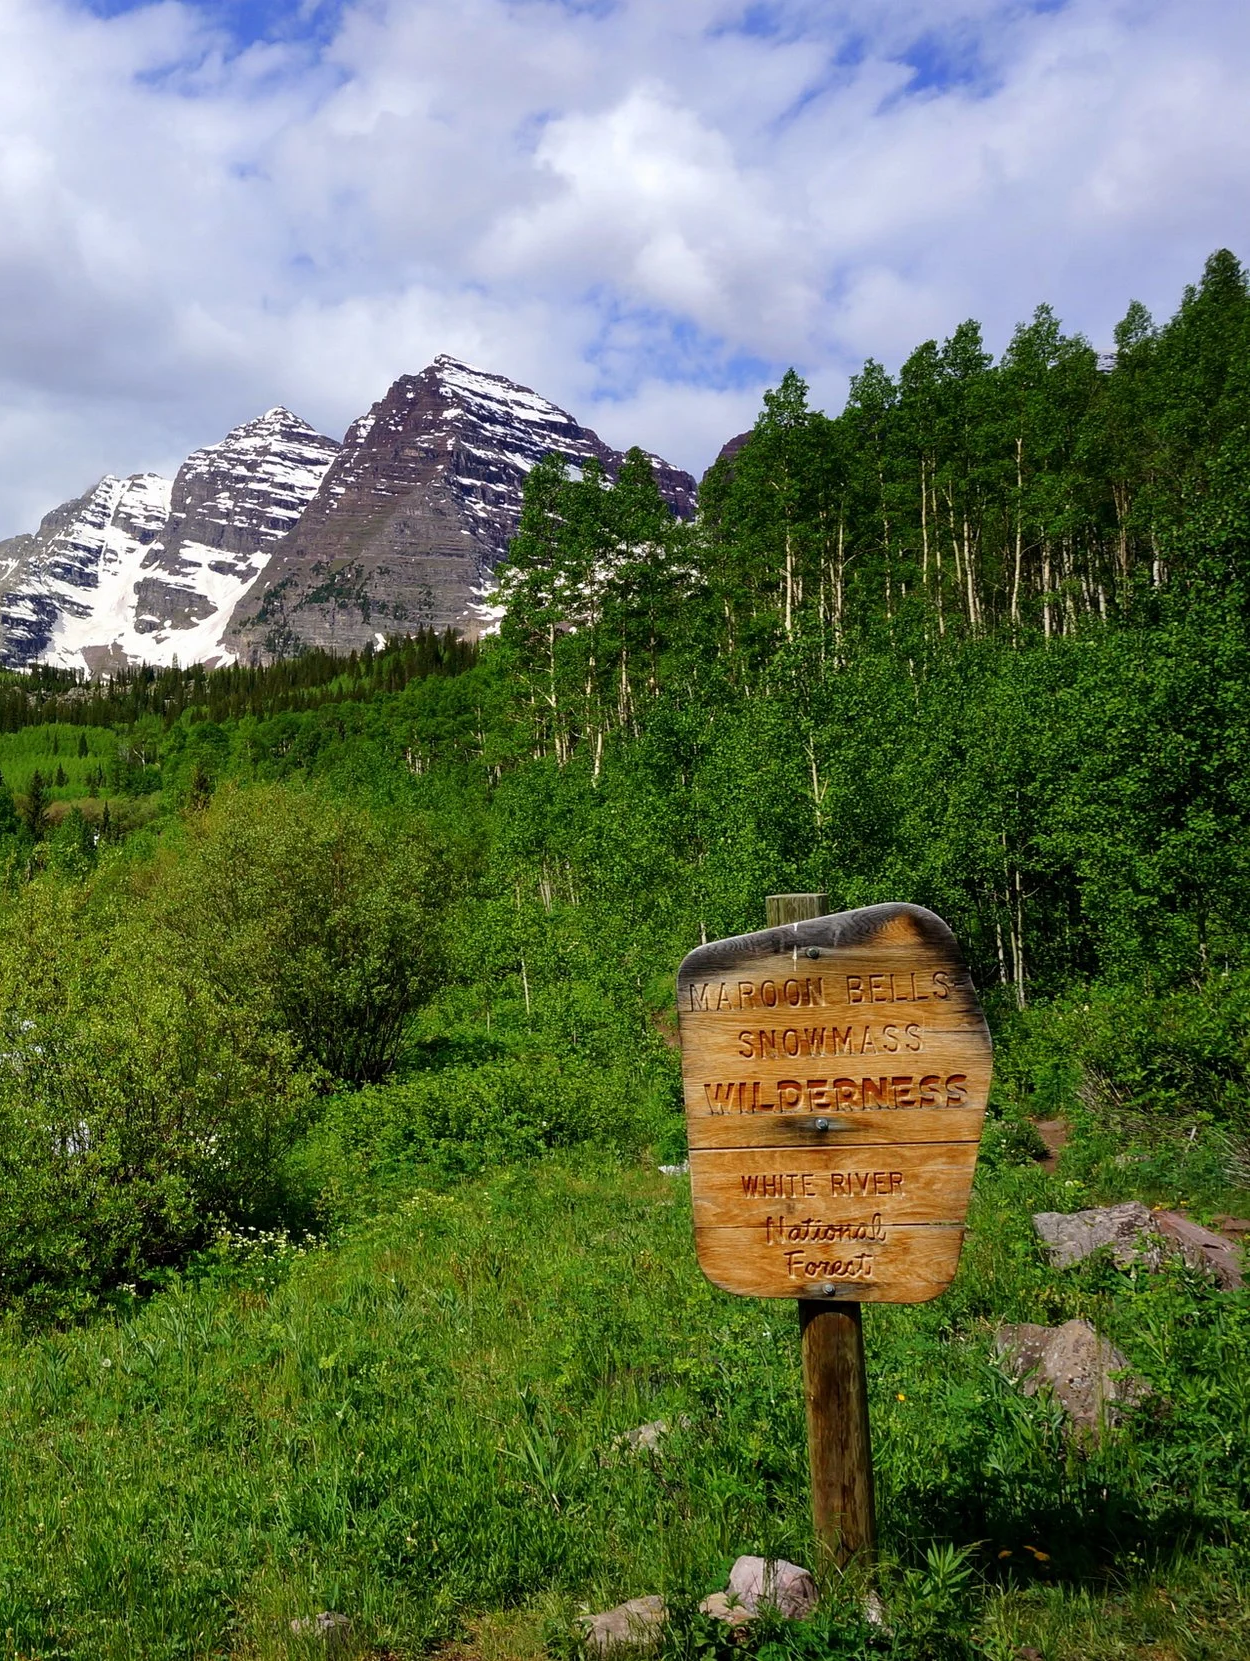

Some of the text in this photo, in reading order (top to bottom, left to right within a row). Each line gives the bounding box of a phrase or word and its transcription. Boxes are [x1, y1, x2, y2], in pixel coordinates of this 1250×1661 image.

[690, 977, 826, 1012] MAROON
[738, 1023, 925, 1060] SNOWMASS
[704, 1074, 968, 1116] WILDERNESS
[741, 1172, 906, 1199] WHITE RIVER
[766, 1213, 887, 1245] National
[784, 1250, 873, 1279] Forest
